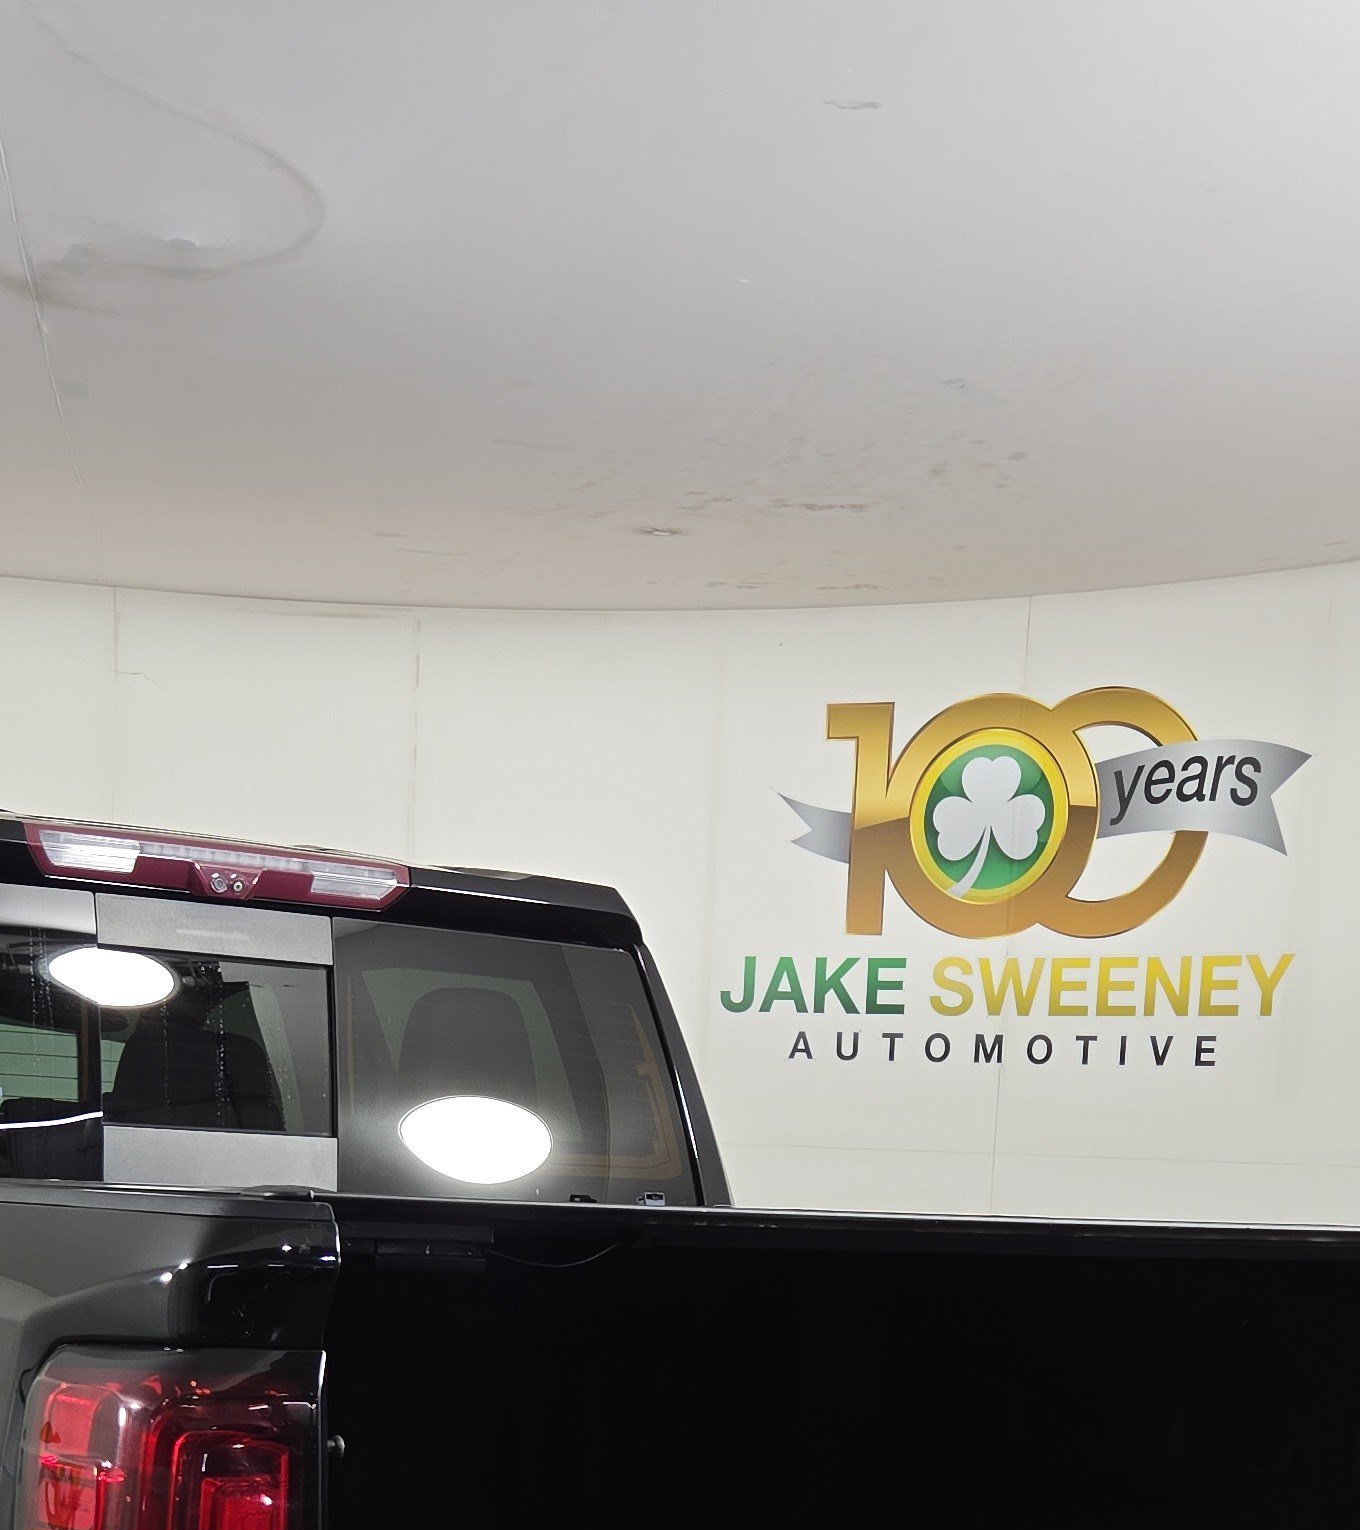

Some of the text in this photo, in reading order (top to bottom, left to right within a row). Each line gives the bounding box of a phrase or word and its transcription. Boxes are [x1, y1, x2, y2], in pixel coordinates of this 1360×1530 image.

[825, 685, 1210, 940] 100
[1110, 748, 1262, 826] years
[720, 953, 1296, 1018] JAKE SWEENEY
[788, 1030, 1219, 1067] AUTOMOTIVE
